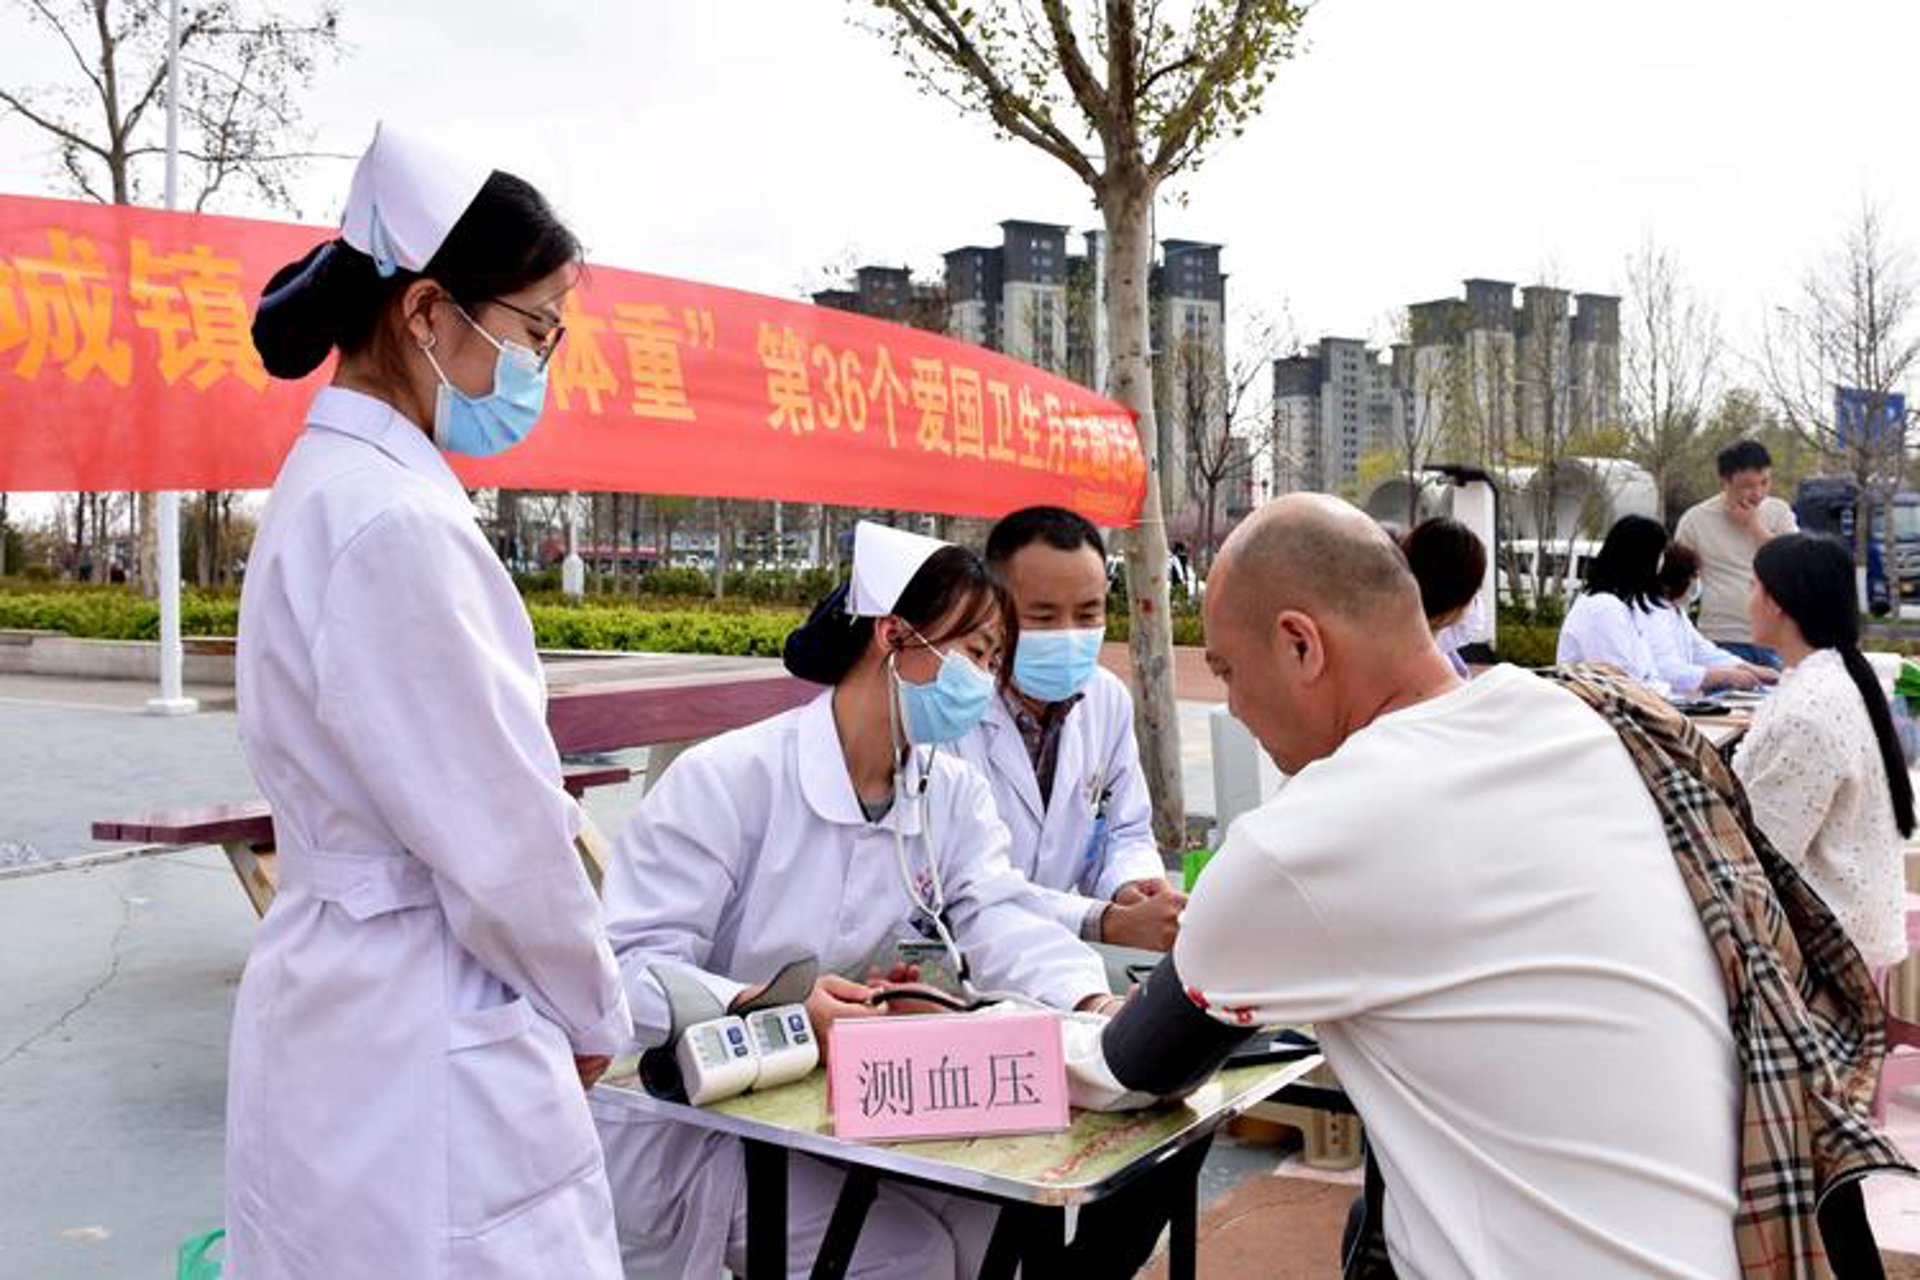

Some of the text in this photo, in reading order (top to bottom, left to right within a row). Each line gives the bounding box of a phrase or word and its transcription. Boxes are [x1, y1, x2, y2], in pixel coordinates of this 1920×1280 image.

[0, 226, 269, 393] 城镇
[858, 1051, 1041, 1117] 测血压
